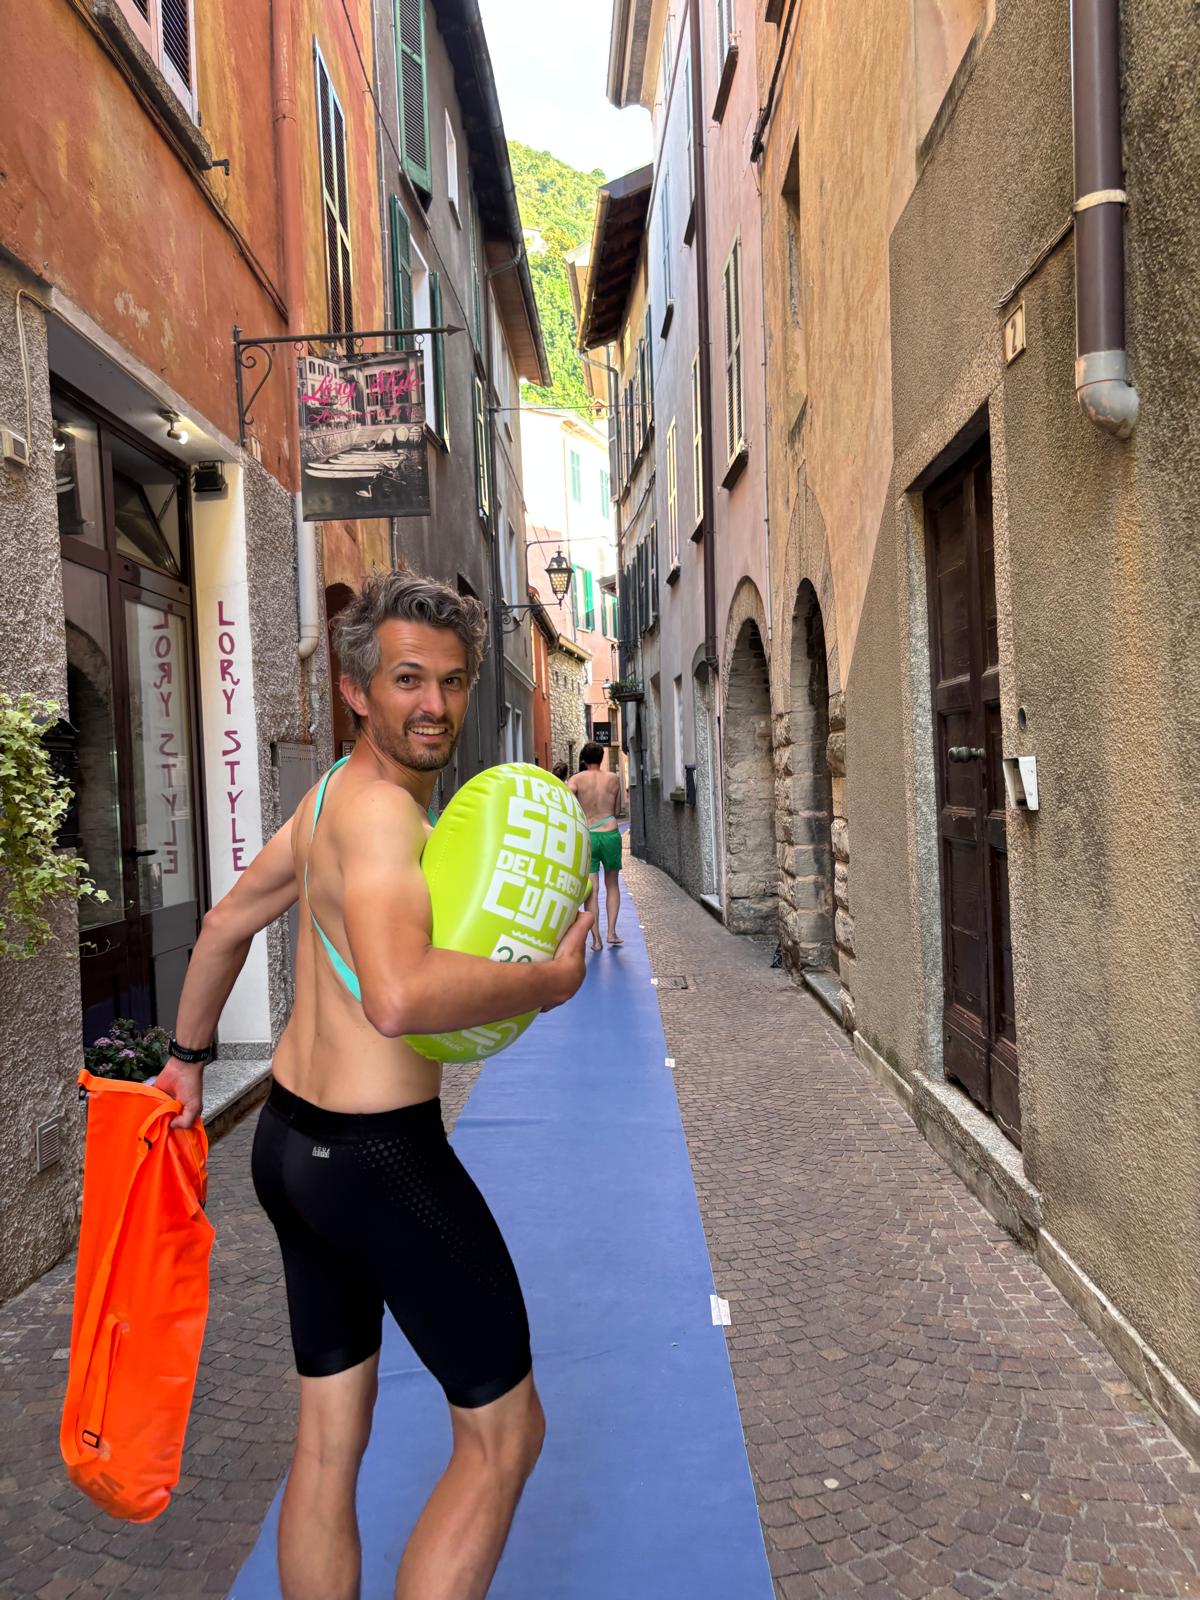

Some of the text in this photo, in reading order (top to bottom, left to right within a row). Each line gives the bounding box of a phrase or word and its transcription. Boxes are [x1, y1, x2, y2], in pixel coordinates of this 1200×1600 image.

[370, 367, 419, 402] Style
[217, 601, 248, 872] LORY STYLE
[496, 850, 540, 882] DEL
